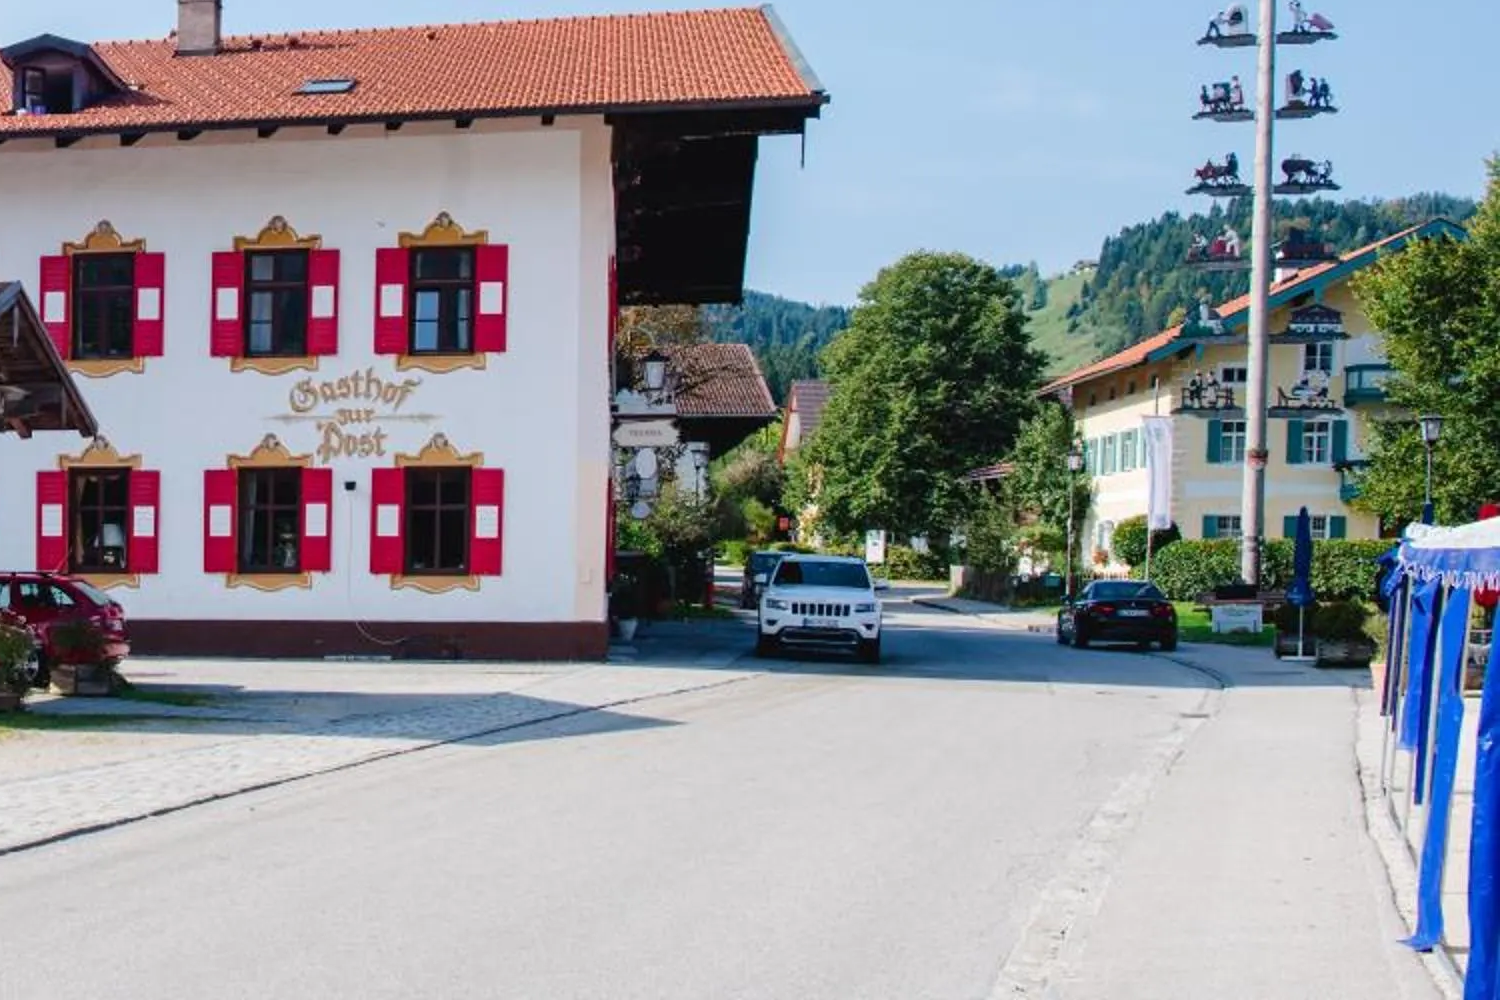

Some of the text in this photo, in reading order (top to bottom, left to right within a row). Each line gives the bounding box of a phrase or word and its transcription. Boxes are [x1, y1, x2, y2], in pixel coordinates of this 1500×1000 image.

[289, 366, 423, 413] Gasthof
[336, 407, 375, 426] zur
[316, 421, 388, 465] Post
